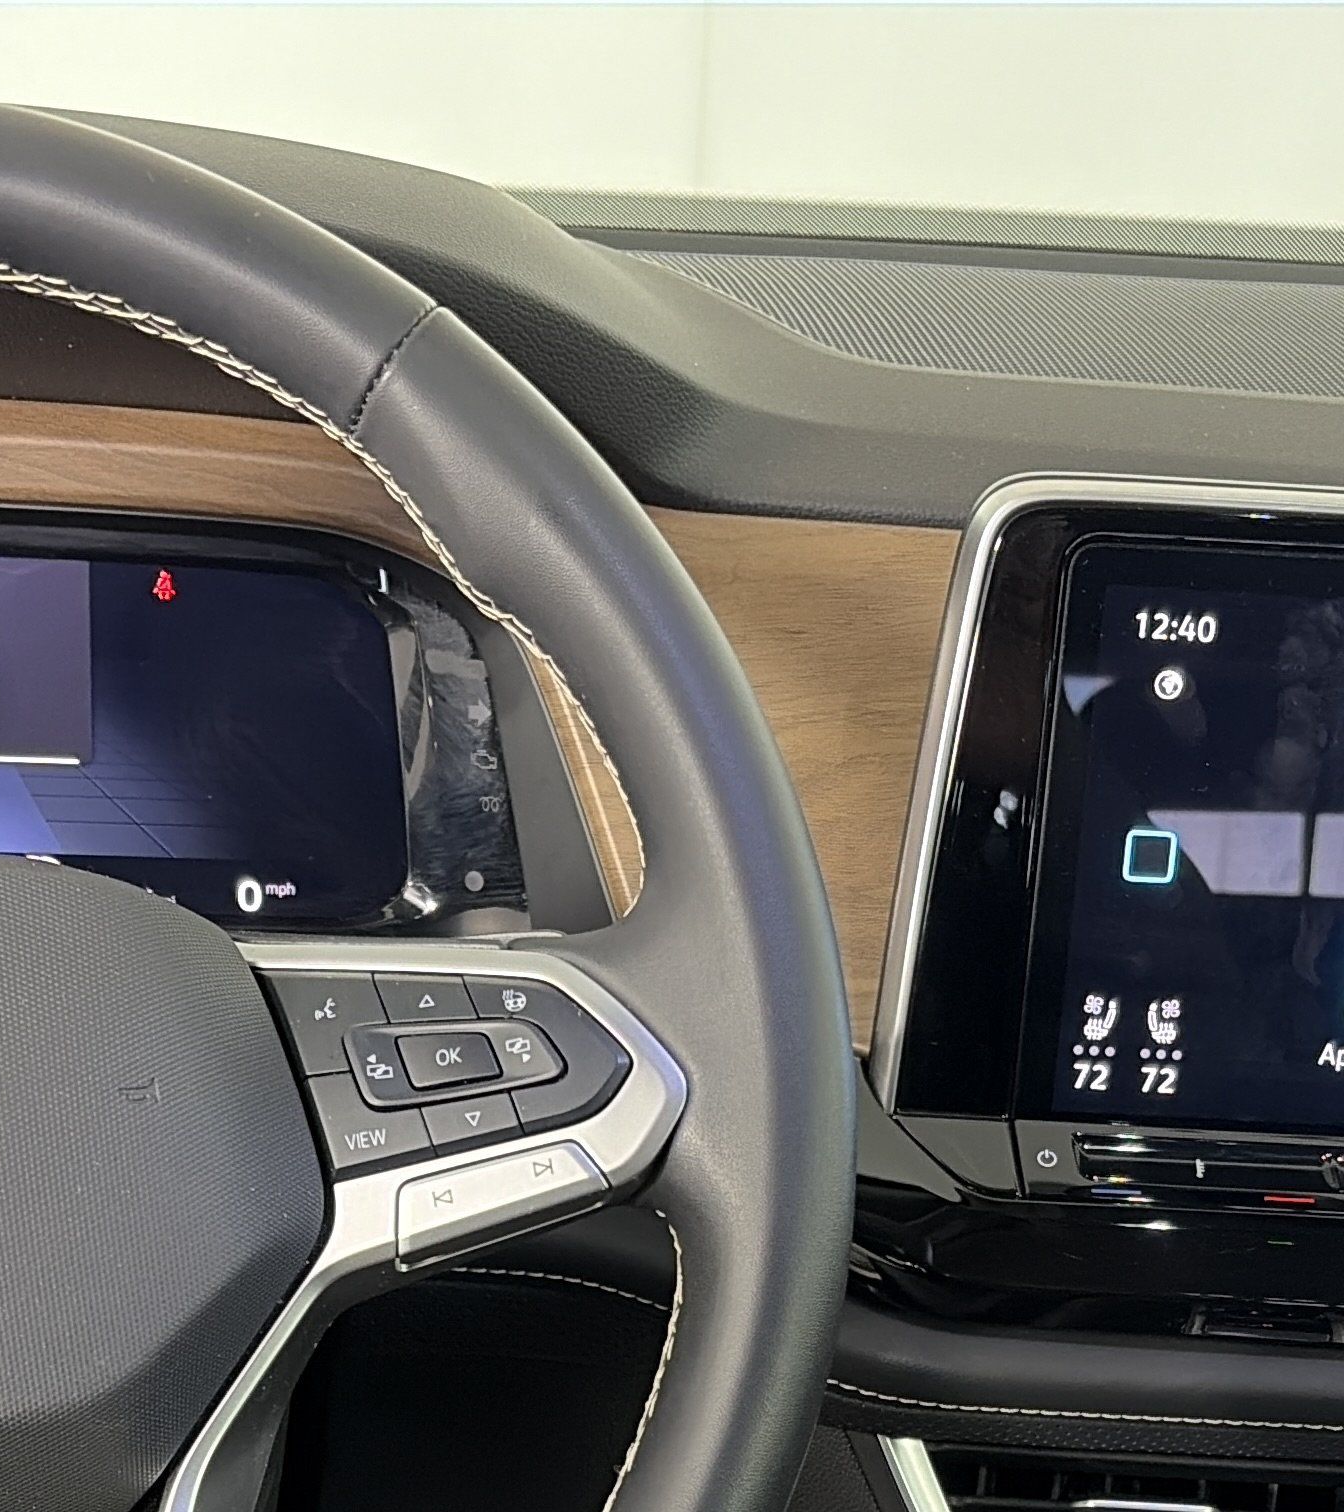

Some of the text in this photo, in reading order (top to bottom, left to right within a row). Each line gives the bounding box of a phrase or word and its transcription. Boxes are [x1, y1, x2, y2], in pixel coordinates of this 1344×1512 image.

[1135, 611, 1217, 644] 12:40
[236, 878, 297, 913] 0 mph
[435, 1046, 463, 1067] OK
[1073, 1064, 1109, 1092] 72
[1141, 1067, 1176, 1094] 72
[344, 1129, 387, 1150] VIEW
